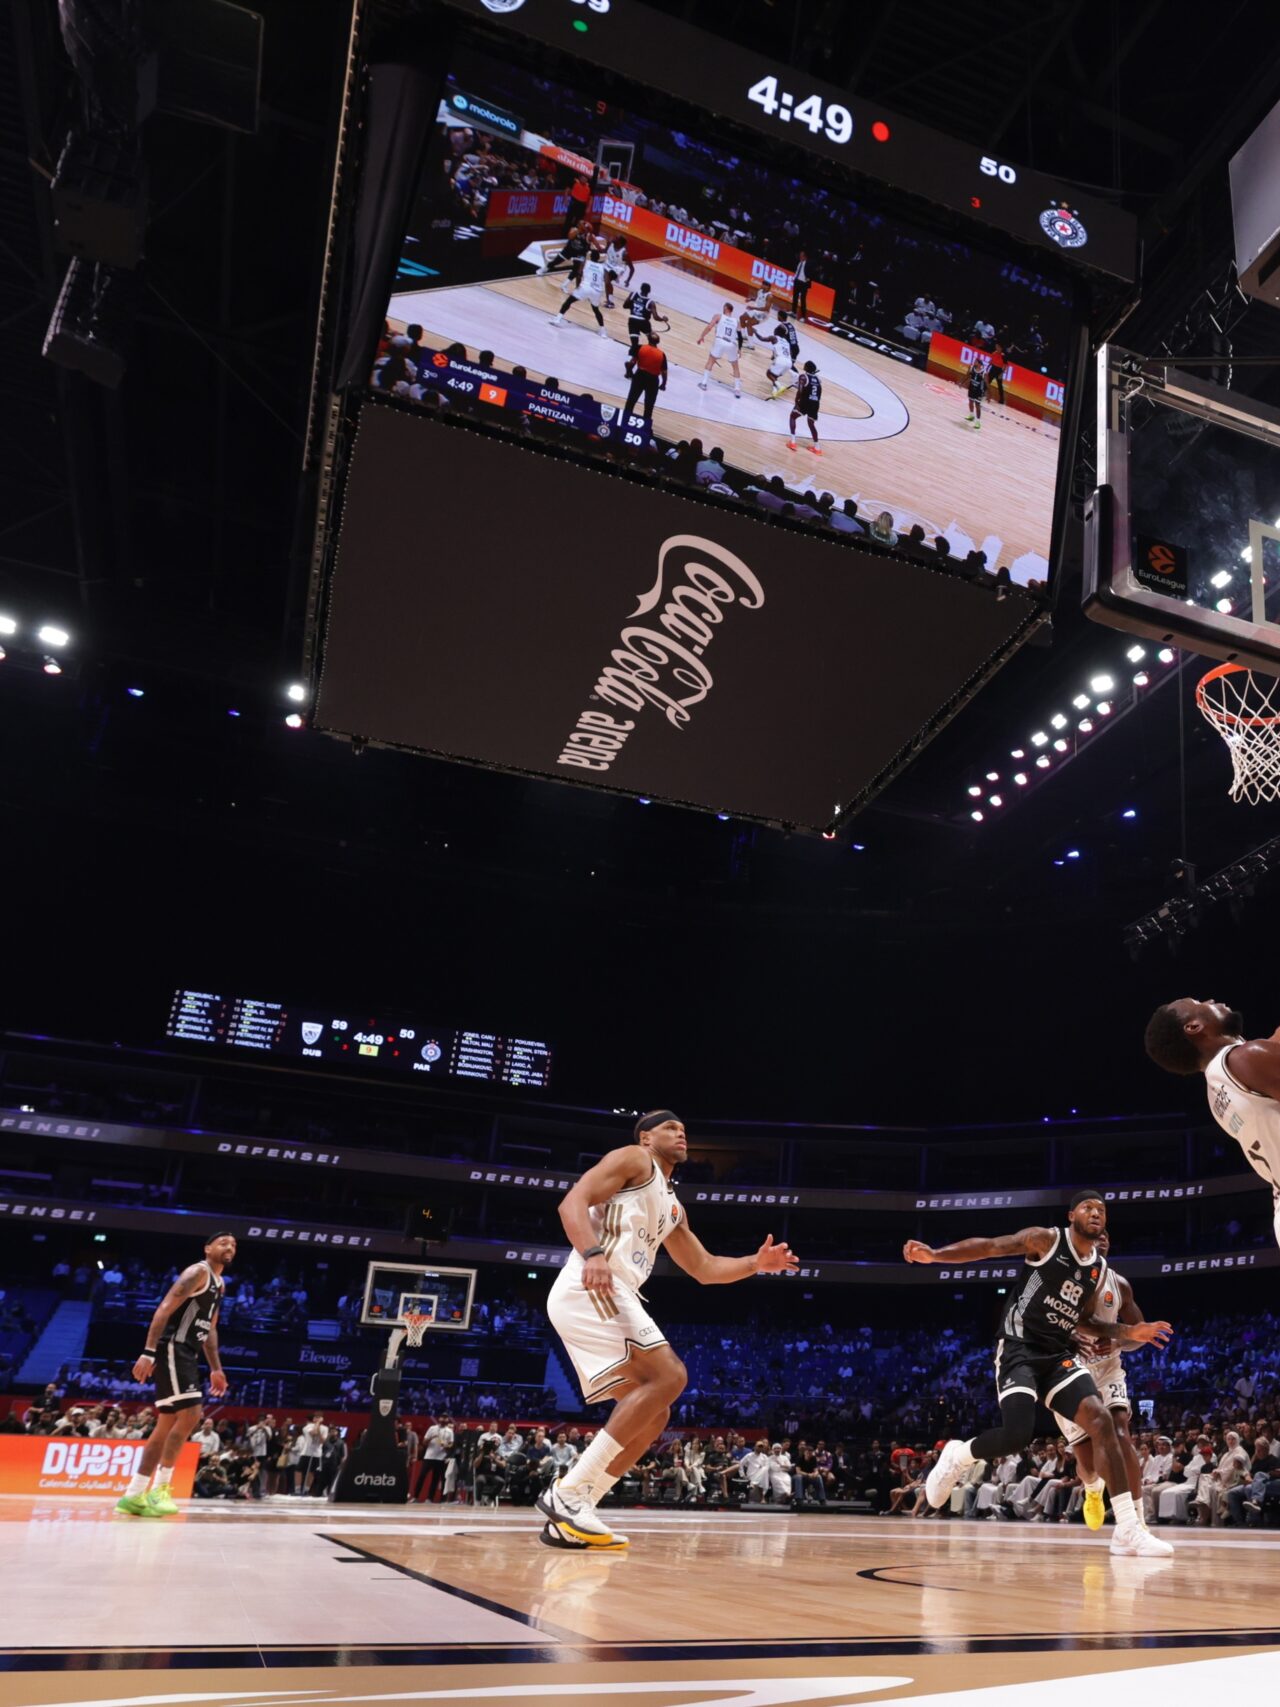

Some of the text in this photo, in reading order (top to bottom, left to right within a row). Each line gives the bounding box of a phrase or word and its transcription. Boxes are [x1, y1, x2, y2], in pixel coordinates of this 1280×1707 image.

[468, 103, 518, 132] motorola
[747, 75, 853, 144] 4:49
[979, 156, 1017, 184] 50
[970, 196, 982, 209] 3
[665, 222, 720, 260] DUBAI
[449, 360, 498, 382] EuroLeague
[446, 377, 474, 392] 4:49
[489, 389, 498, 400] 9
[540, 388, 570, 405] DUBAI
[528, 402, 575, 424] PARTIZAN
[627, 415, 645, 429] 59
[624, 432, 642, 446] 50
[1138, 568, 1187, 591] EuroLeague
[594, 534, 765, 731] Coca-Cola
[556, 710, 636, 772] arena
[331, 1019, 348, 1031] 59
[399, 1028, 415, 1039] 50
[353, 1032, 384, 1045] 4:49
[302, 1047, 322, 1057] DUB
[413, 1062, 431, 1072] PAR
[218, 1141, 341, 1165] DEFENSE!
[696, 1191, 799, 1205] DEFENSE!
[1104, 1185, 1204, 1201] DEFENSE!
[915, 1195, 1013, 1210] DEFENSE!
[247, 1226, 372, 1247] DEFENSE!
[1161, 1255, 1255, 1273] DEFENSE!
[1059, 1279, 1084, 1307] 88
[41, 1442, 145, 1480] DUBAI
[353, 1472, 397, 1488] dnata
